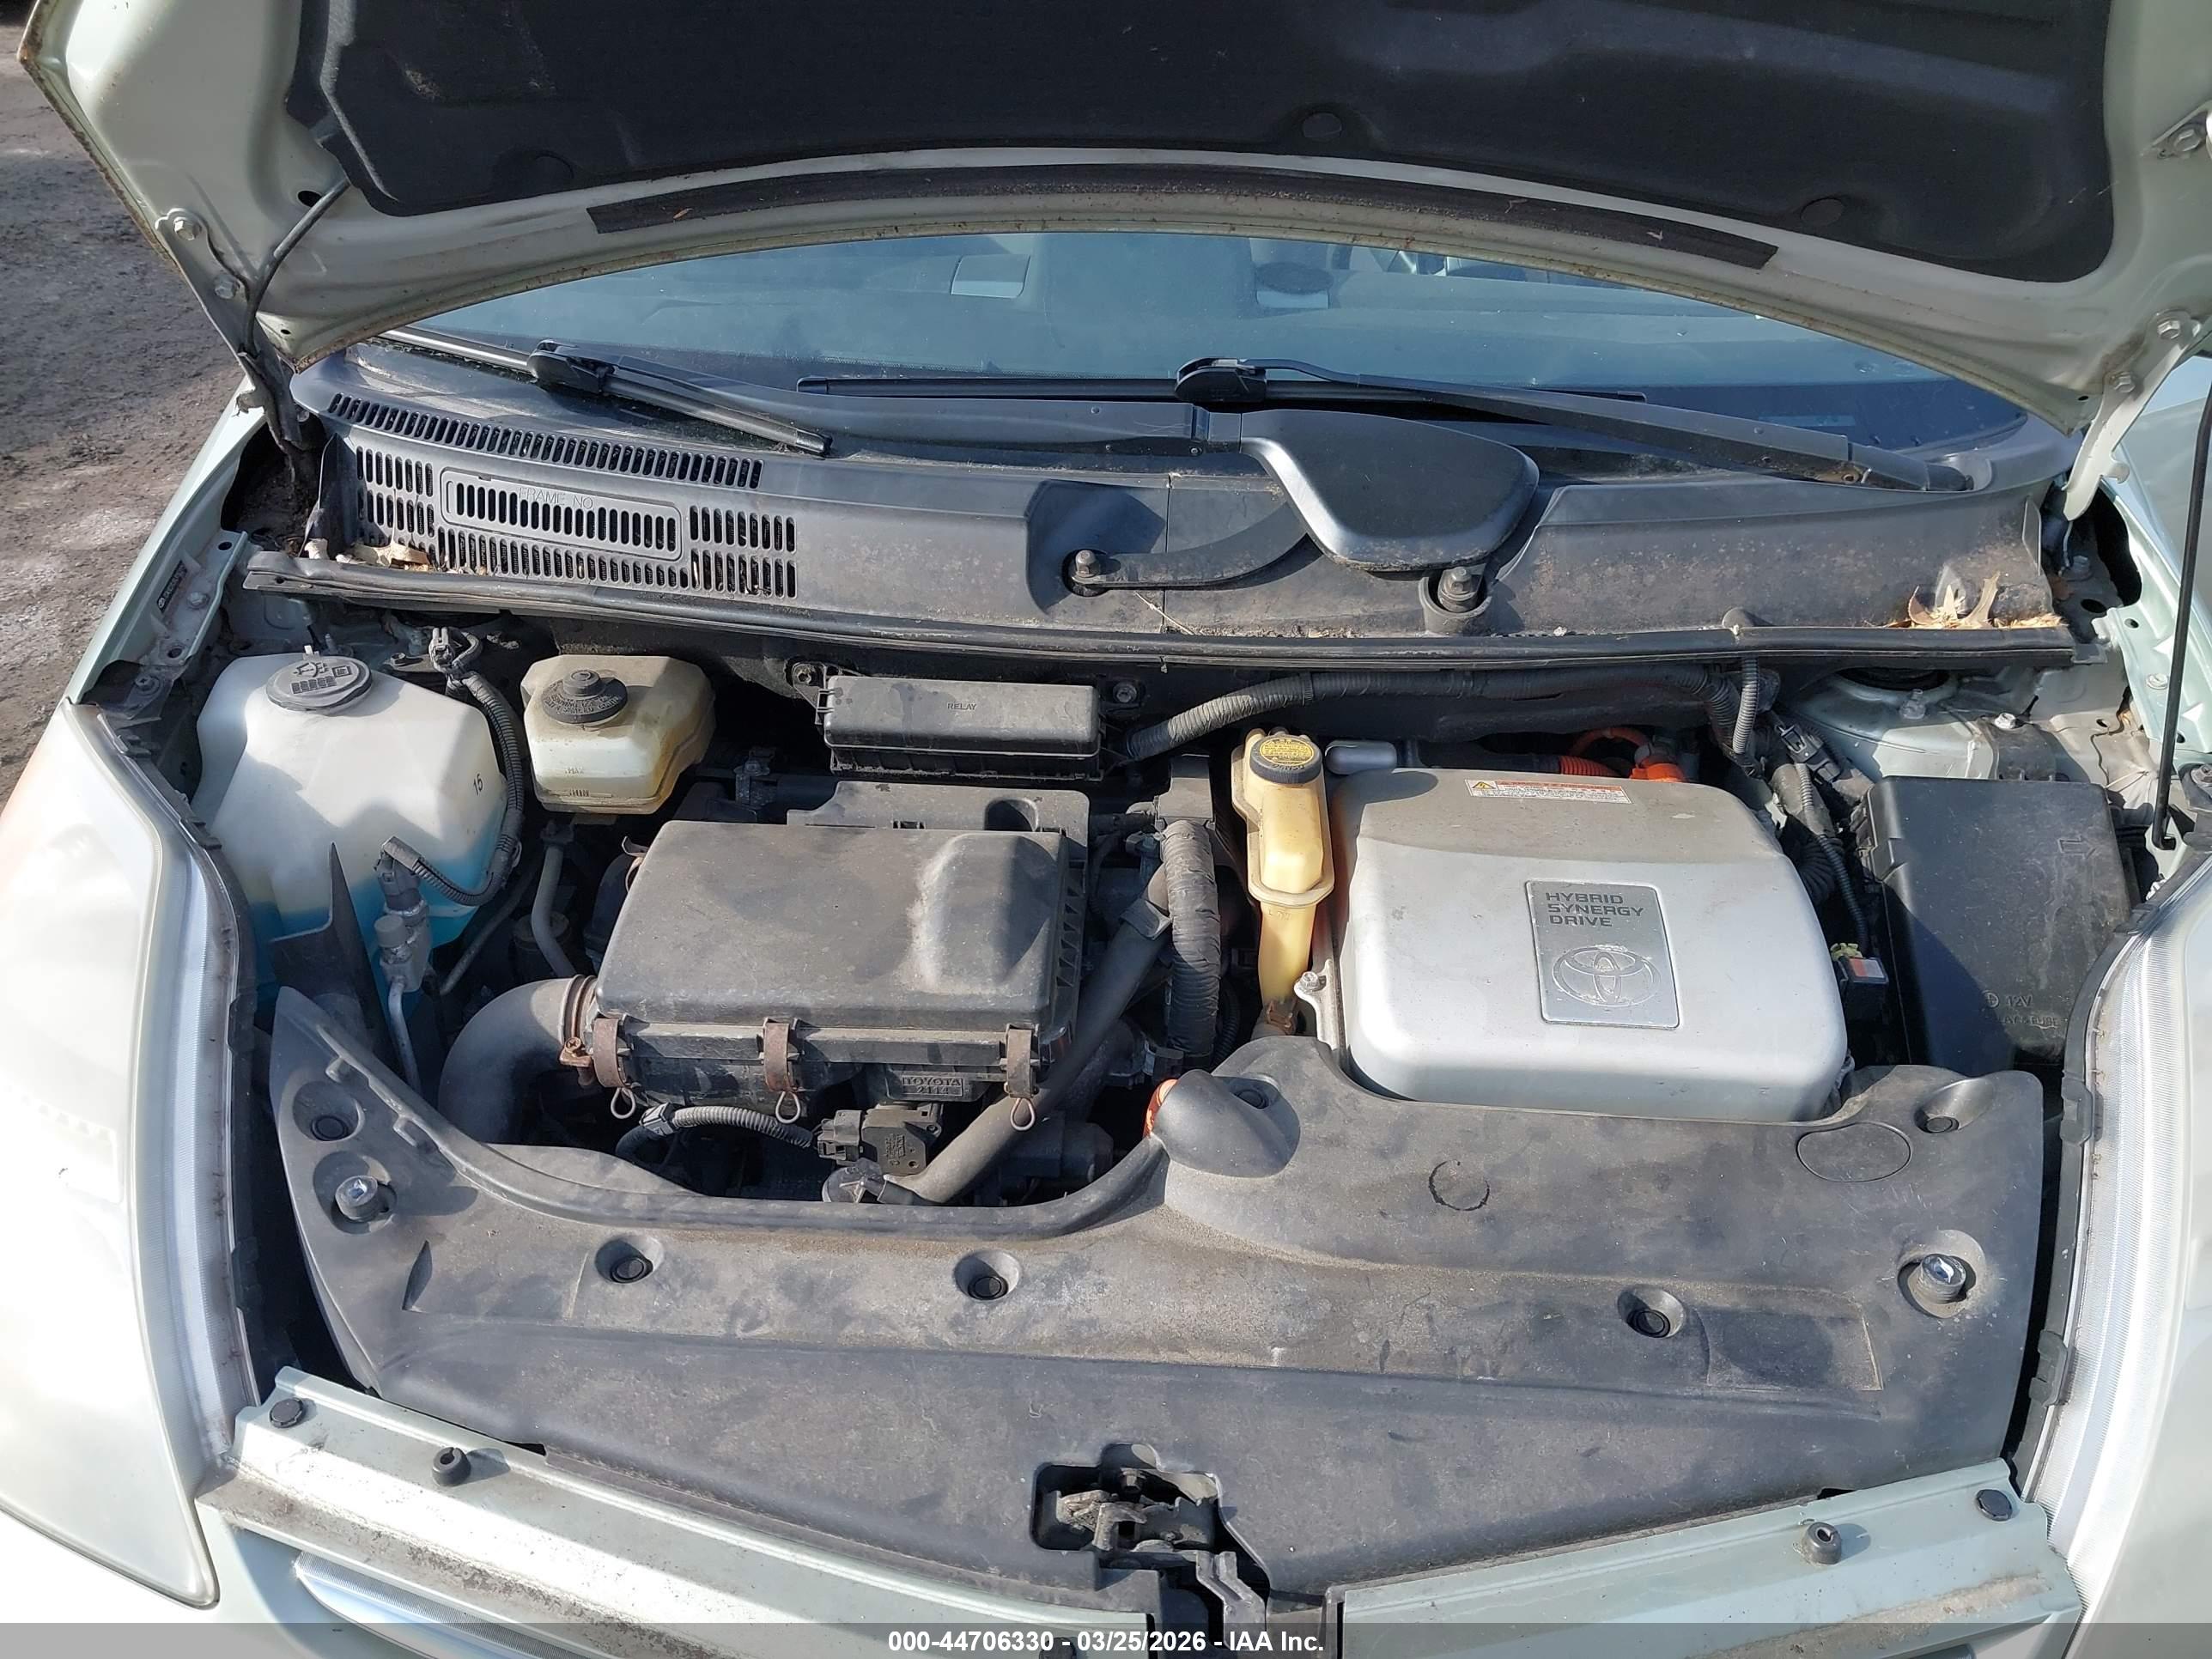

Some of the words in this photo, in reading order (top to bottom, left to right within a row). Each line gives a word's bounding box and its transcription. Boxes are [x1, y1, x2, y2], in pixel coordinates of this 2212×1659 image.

[519, 487, 566, 506] FRAME
[947, 702, 977, 711] RELAY
[1545, 891, 1624, 904] HYBRID
[1547, 902, 1644, 917] SYNERGY
[1549, 915, 1613, 927] DRIVE
[902, 1076, 961, 1086] TOYOTA
